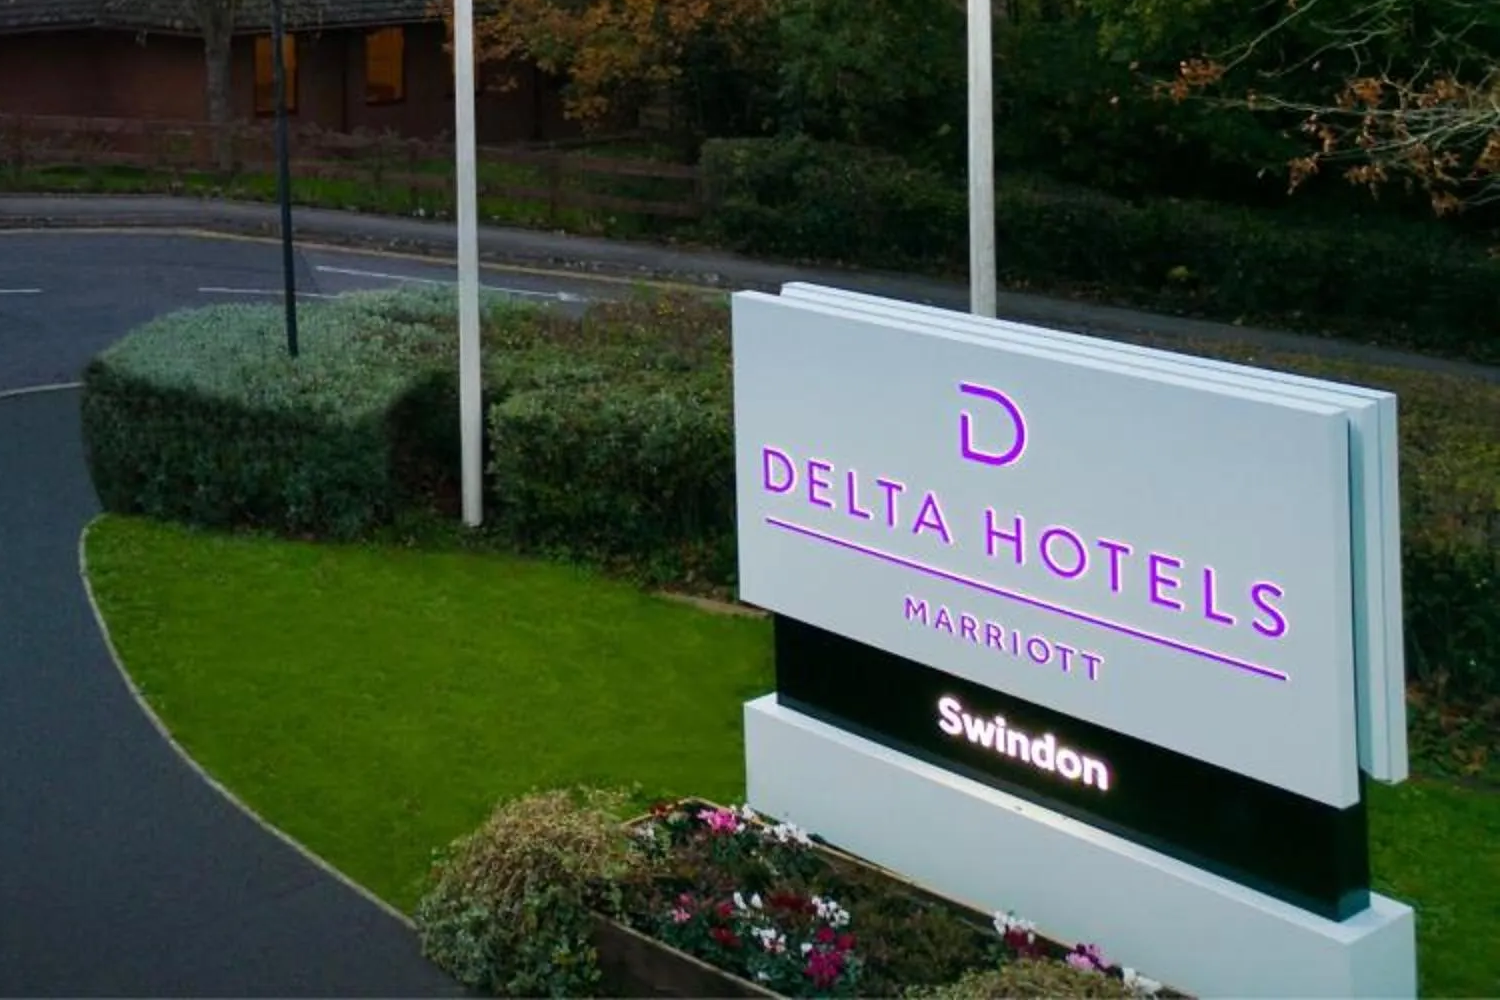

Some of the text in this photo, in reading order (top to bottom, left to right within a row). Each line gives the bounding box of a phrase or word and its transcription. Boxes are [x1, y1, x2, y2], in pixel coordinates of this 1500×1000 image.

[957, 381, 1028, 468] D
[761, 445, 1288, 640] DELTA HOTELS
[902, 597, 1104, 681] MARRIOTT
[936, 695, 1111, 792] Swindon
